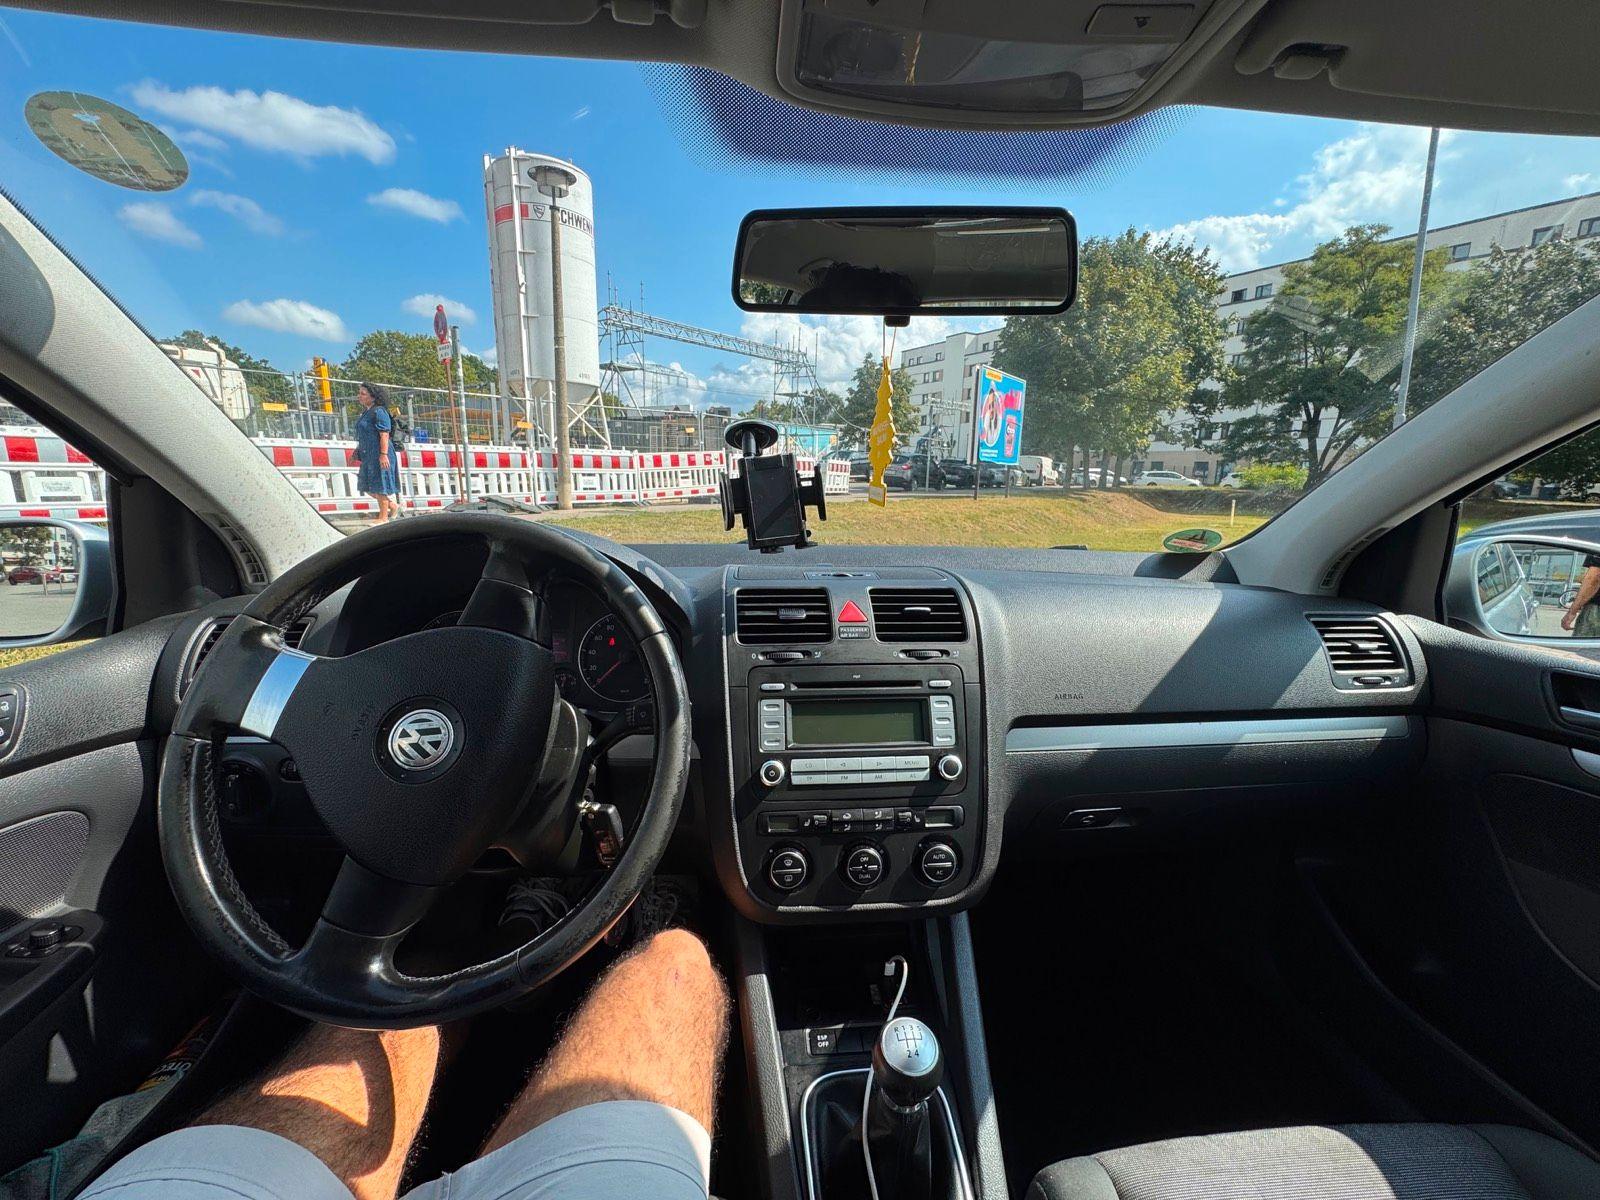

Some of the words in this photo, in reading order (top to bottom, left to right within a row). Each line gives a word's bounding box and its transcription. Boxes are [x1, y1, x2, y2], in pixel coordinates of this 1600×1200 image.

[559, 208, 593, 235] CHWEN
[894, 1025, 900, 1033] R
[906, 1049, 912, 1059] 2
[914, 1049, 920, 1057] 4
